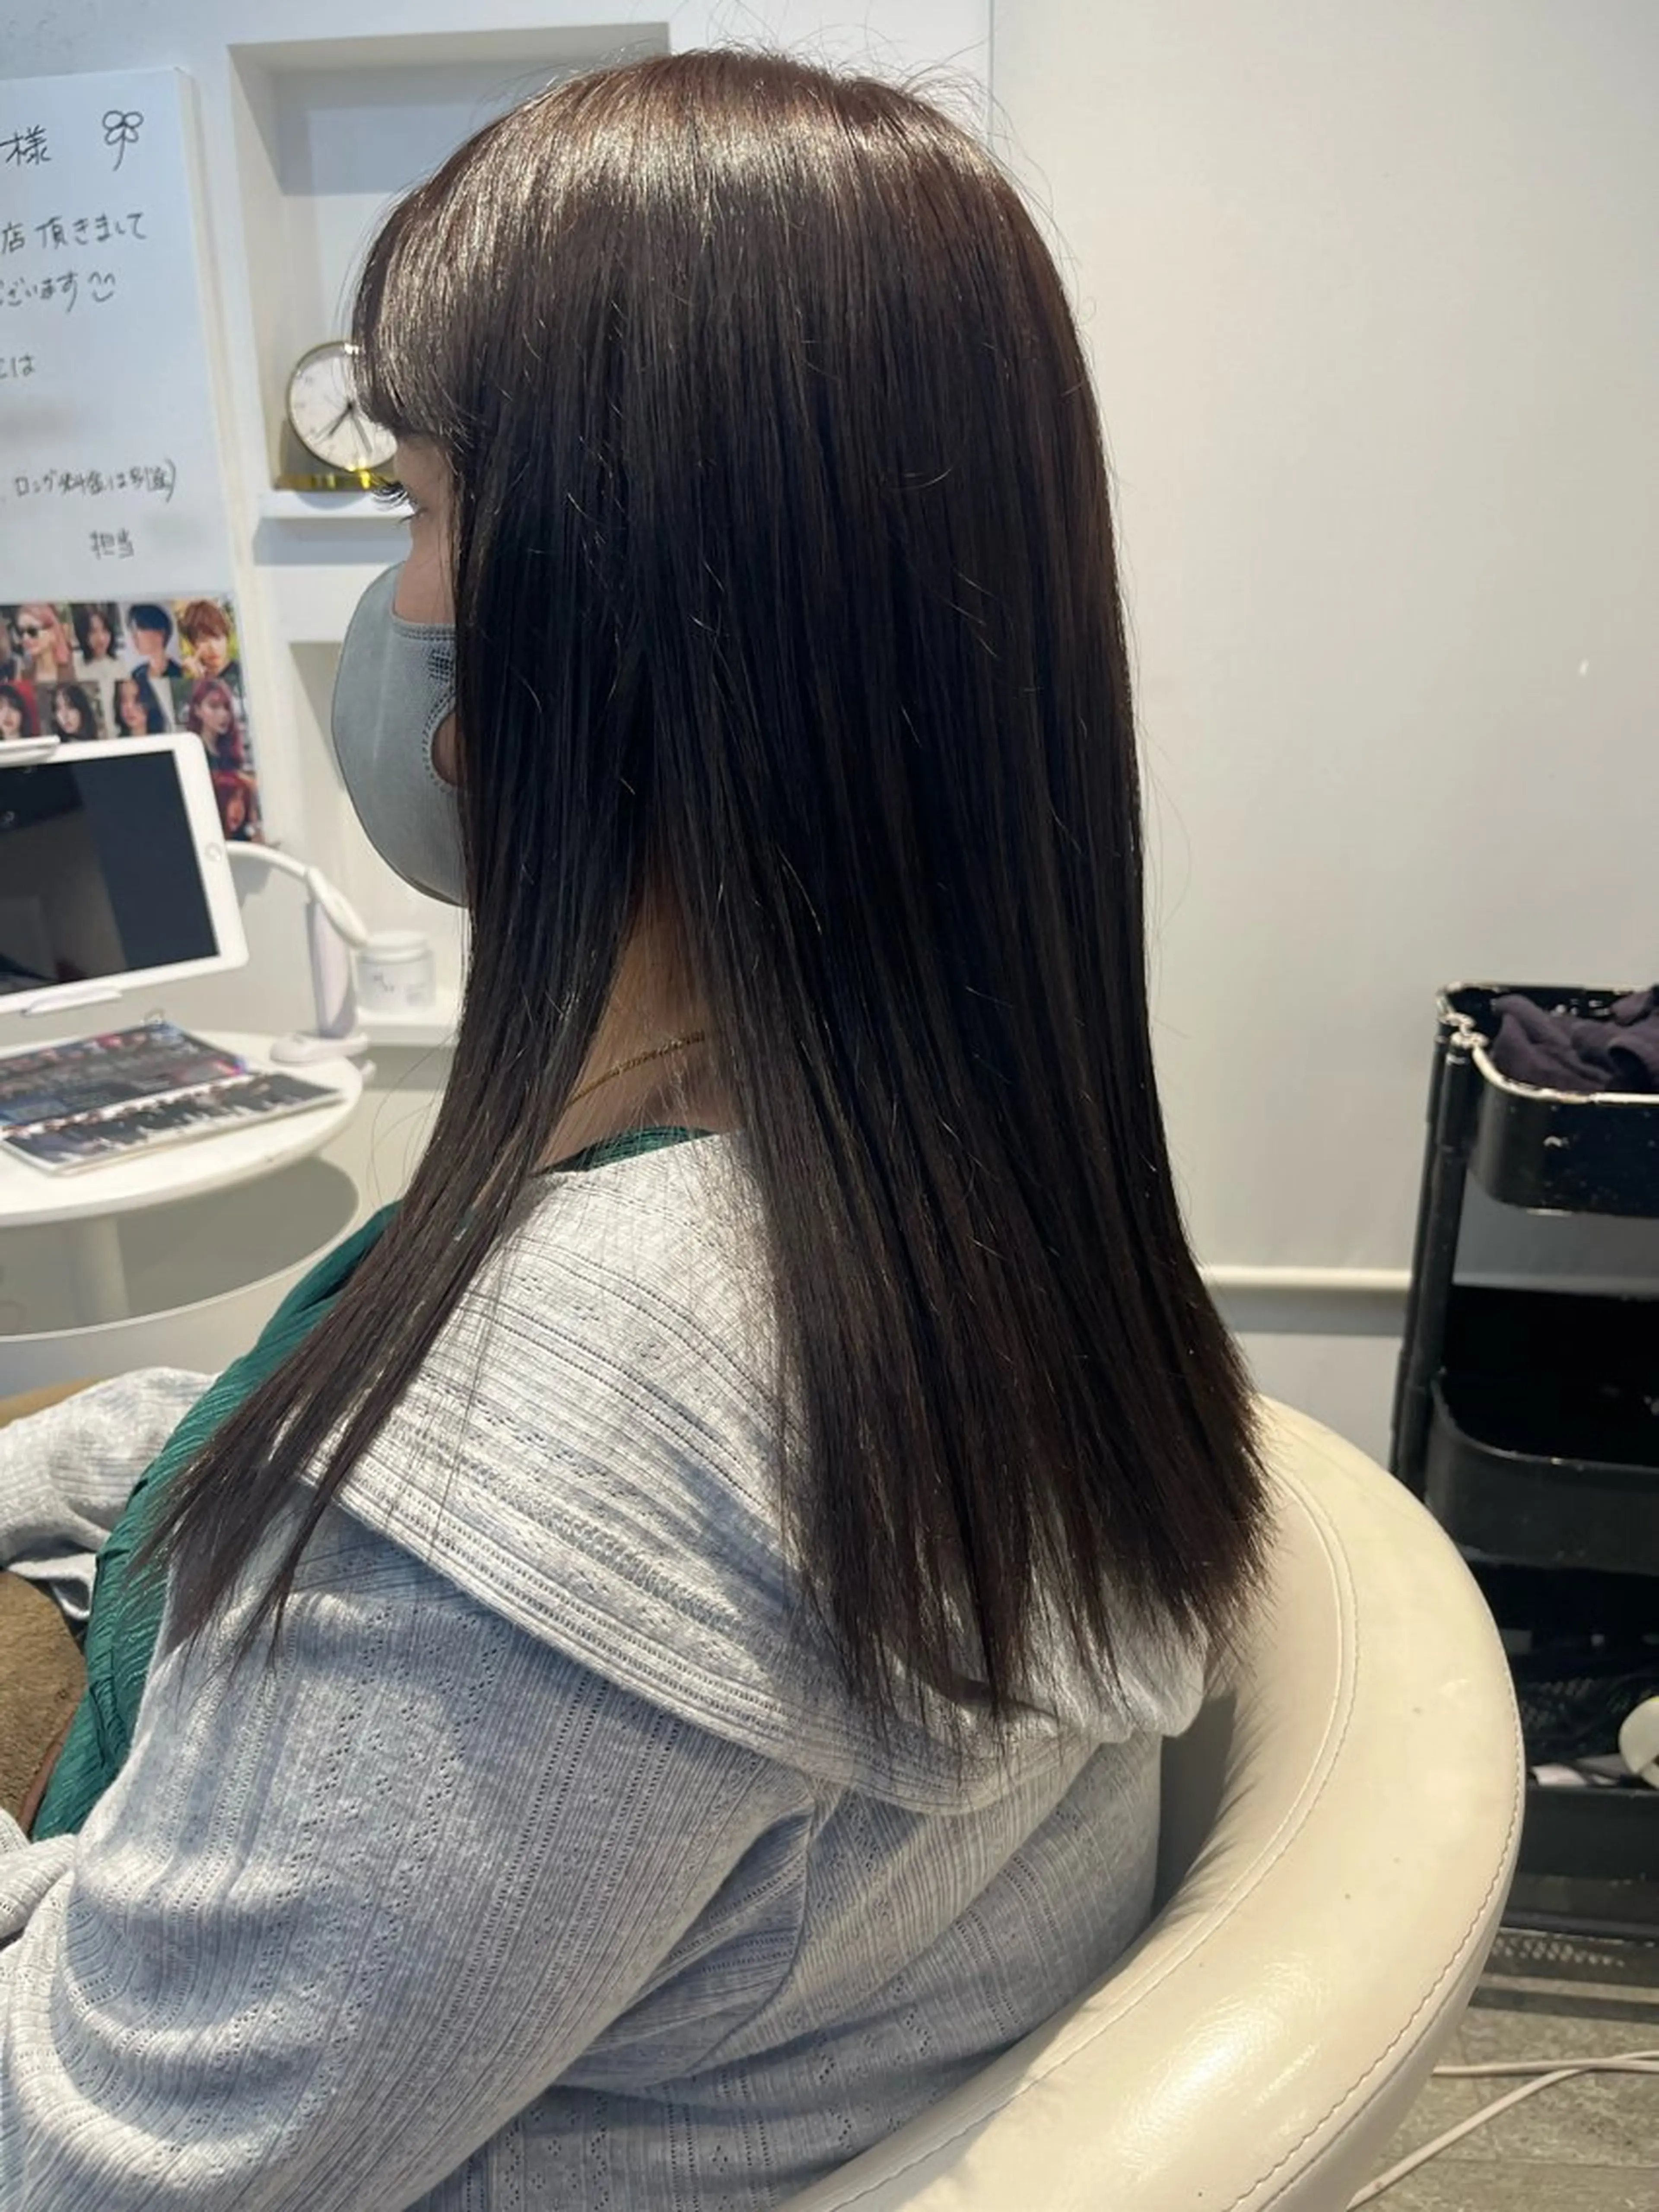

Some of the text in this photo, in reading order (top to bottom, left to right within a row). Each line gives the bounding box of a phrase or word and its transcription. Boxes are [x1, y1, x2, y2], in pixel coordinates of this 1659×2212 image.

[0, 124, 52, 166] 様
[0, 270, 79, 313] ざいます
[89, 528, 134, 559] 担当
